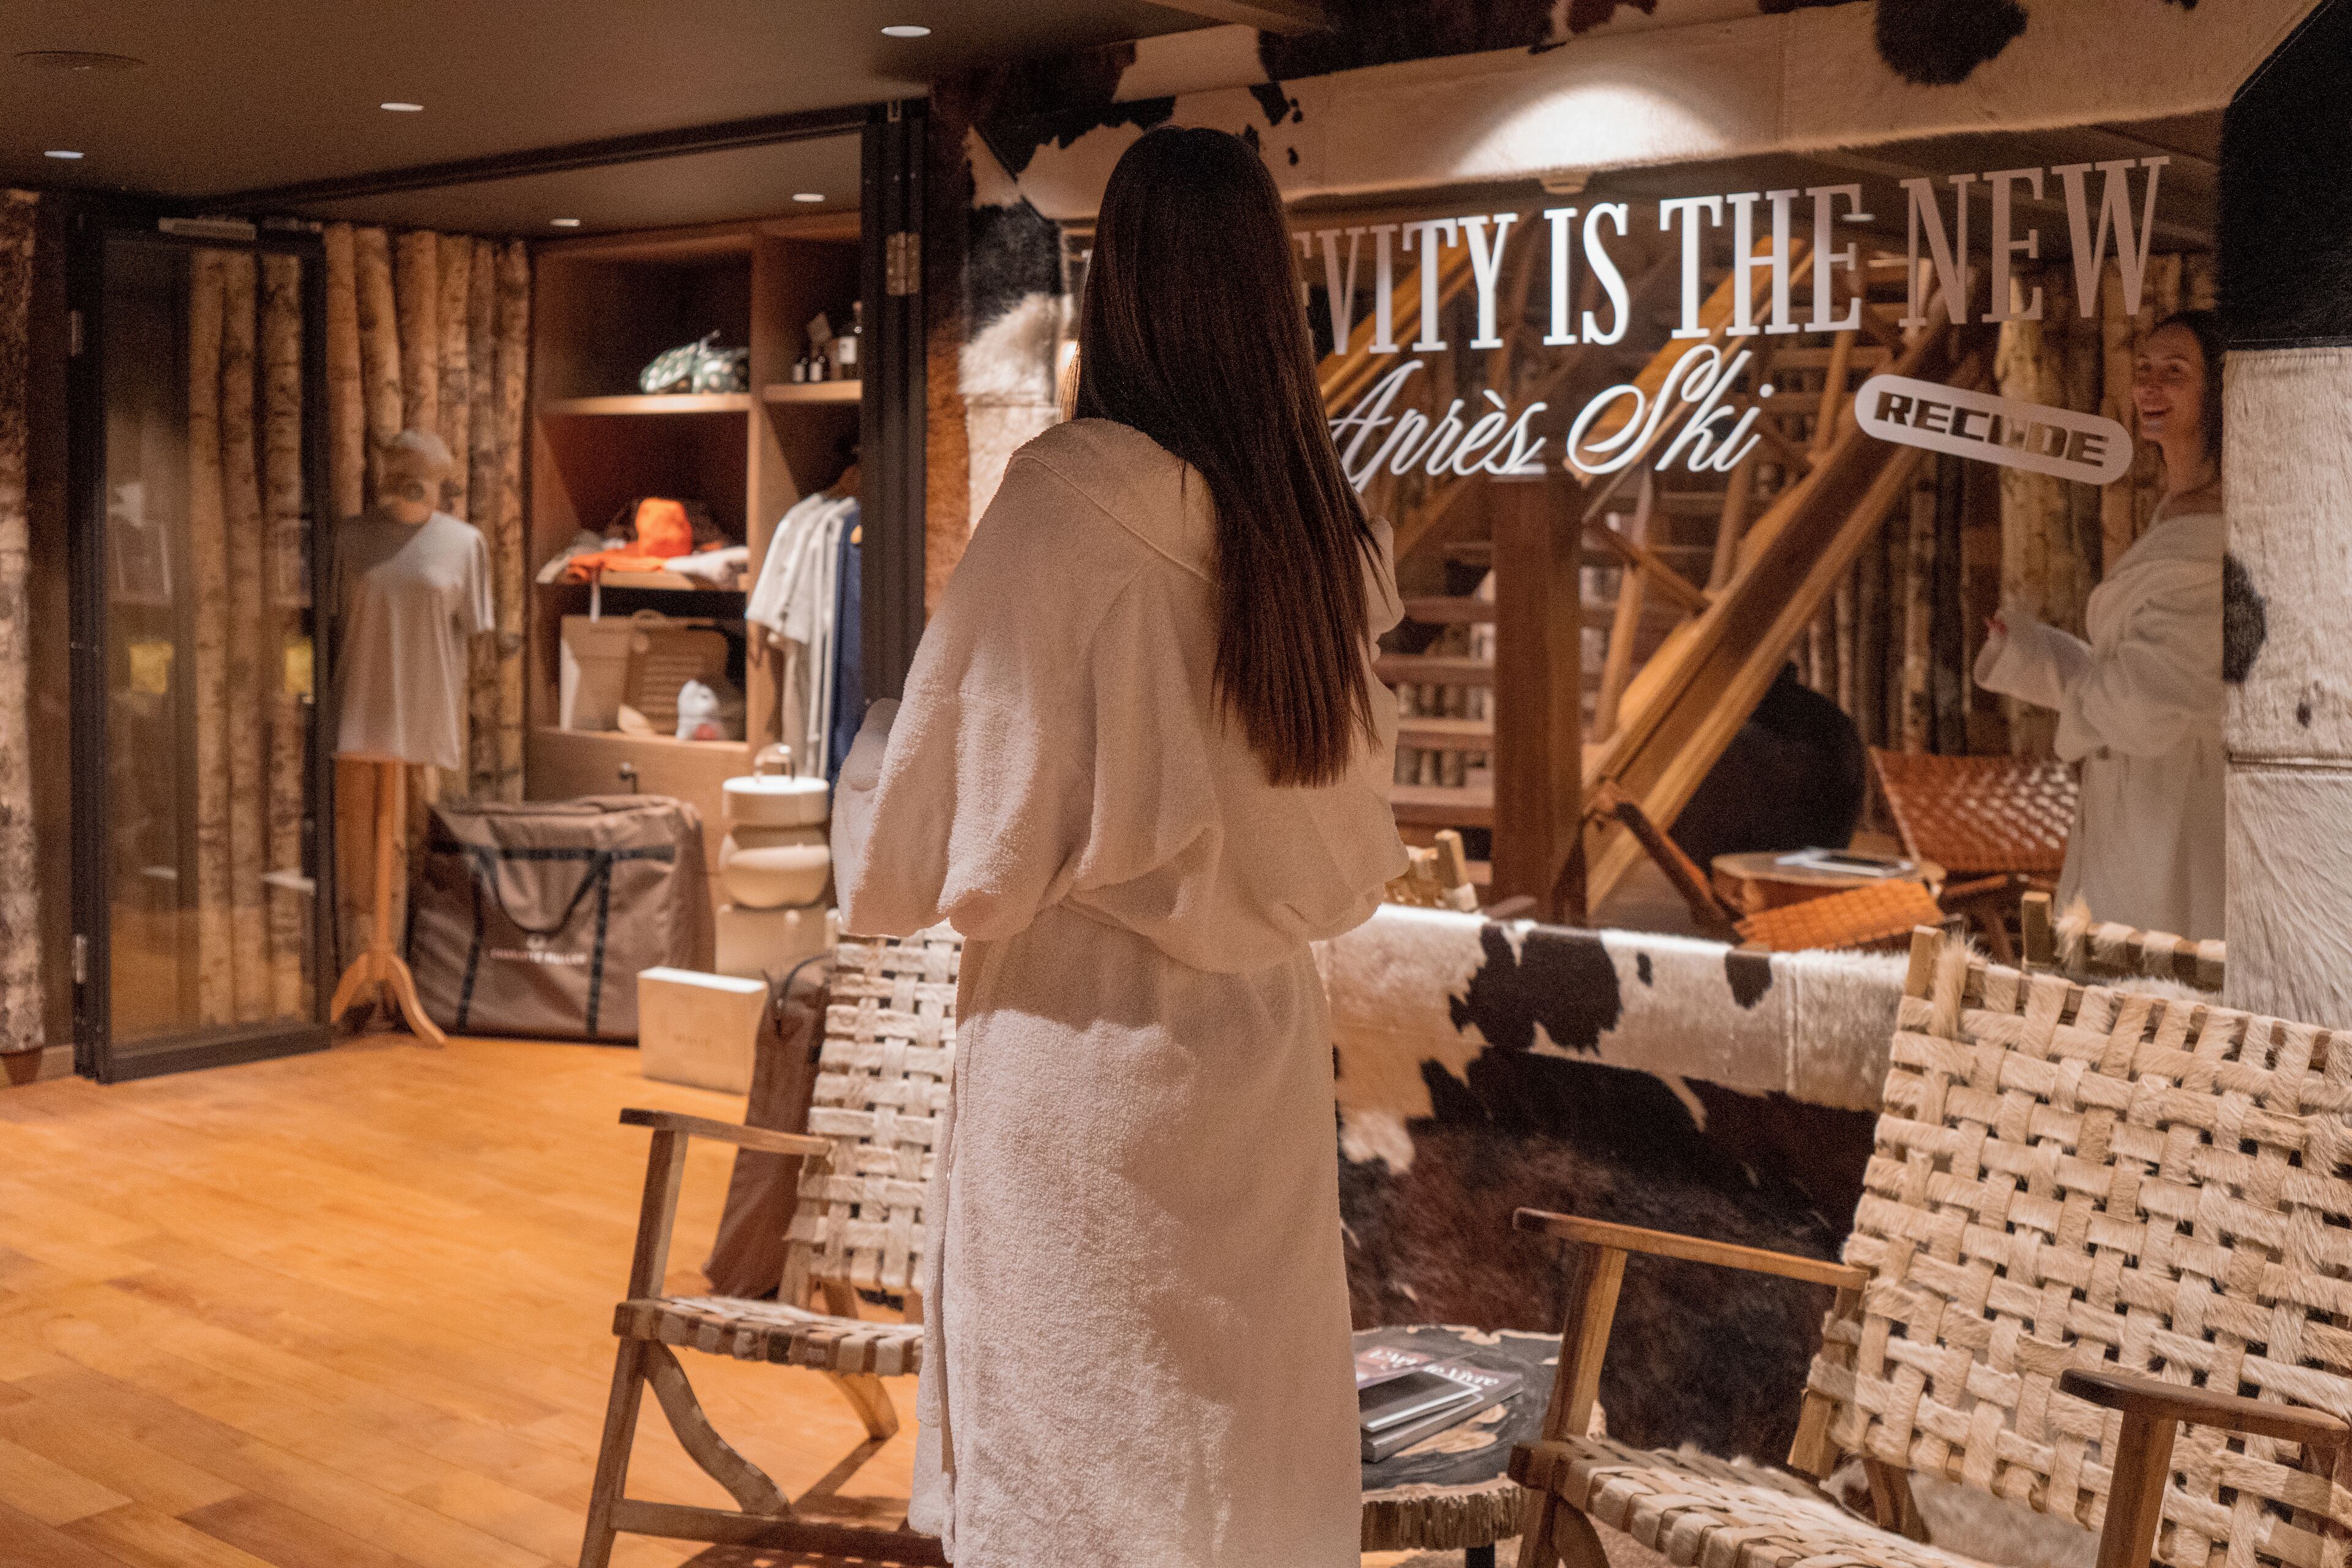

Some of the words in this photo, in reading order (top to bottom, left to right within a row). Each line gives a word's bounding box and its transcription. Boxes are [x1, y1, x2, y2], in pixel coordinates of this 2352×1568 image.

[1543, 203, 1629, 345] IS
[1659, 184, 1862, 339] THE
[1899, 156, 2170, 328] NEW
[1329, 360, 1548, 493] Après
[1566, 344, 1774, 474] Ski
